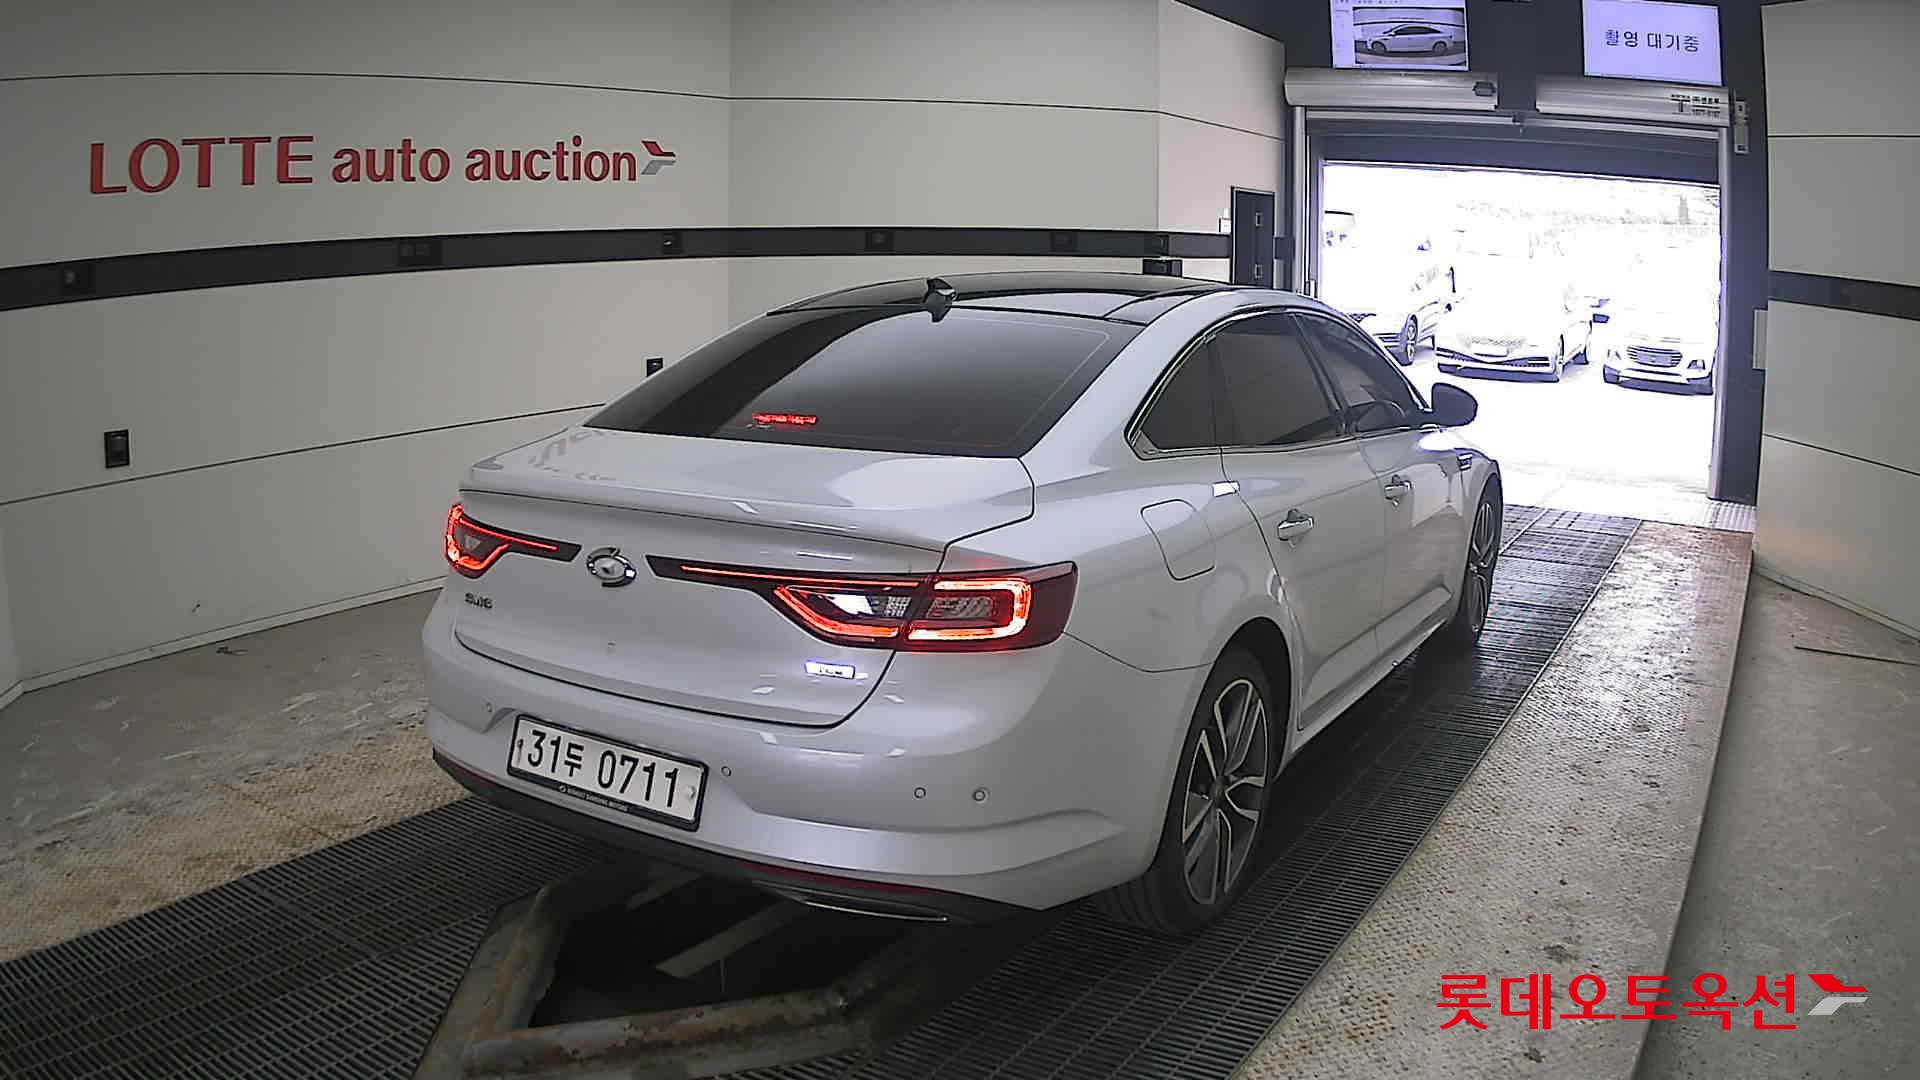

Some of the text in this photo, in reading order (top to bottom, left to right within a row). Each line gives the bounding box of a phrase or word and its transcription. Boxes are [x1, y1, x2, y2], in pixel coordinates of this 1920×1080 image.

[1647, 32, 1700, 52] 대기중
[90, 135, 638, 194] LOTTE auto auction
[527, 729, 585, 777] 31두
[598, 750, 679, 808] 0711
